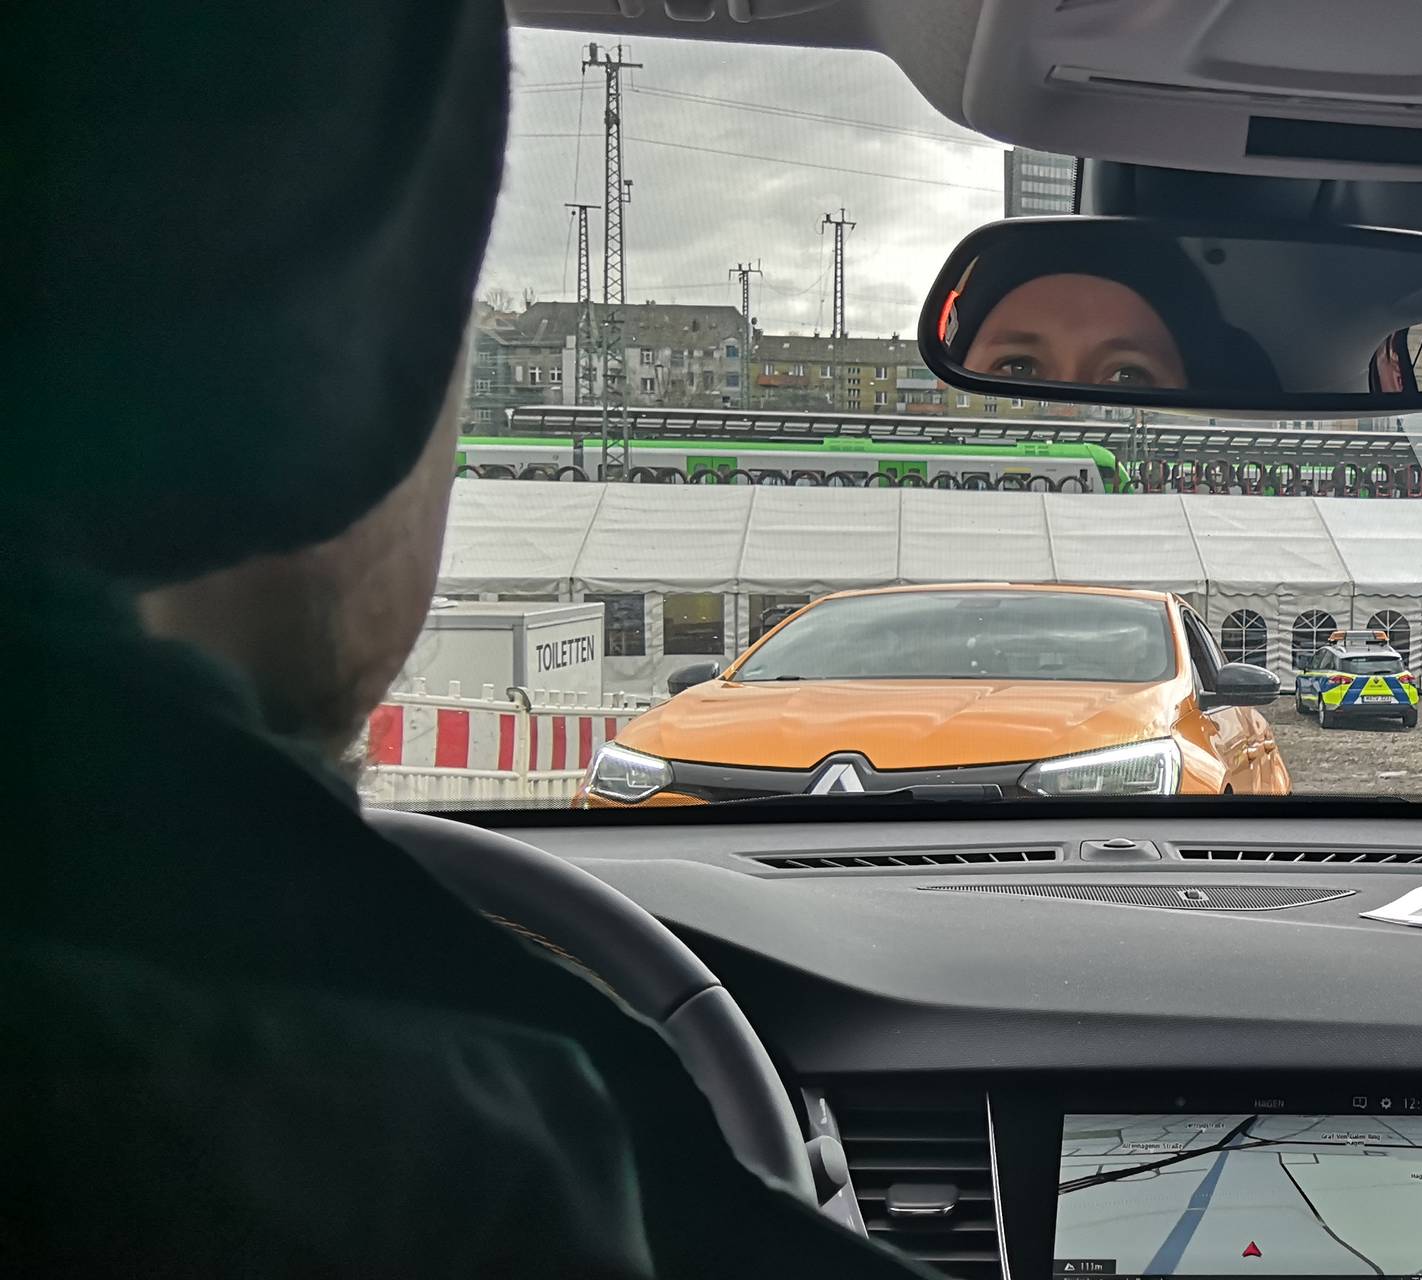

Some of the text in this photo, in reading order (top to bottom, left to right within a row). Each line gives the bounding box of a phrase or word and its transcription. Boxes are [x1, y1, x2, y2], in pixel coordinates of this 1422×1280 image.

[536, 634, 594, 672] TOILETTEN
[1254, 1099, 1285, 1108] HAGEN
[1081, 1262, 1103, 1272] 111m
